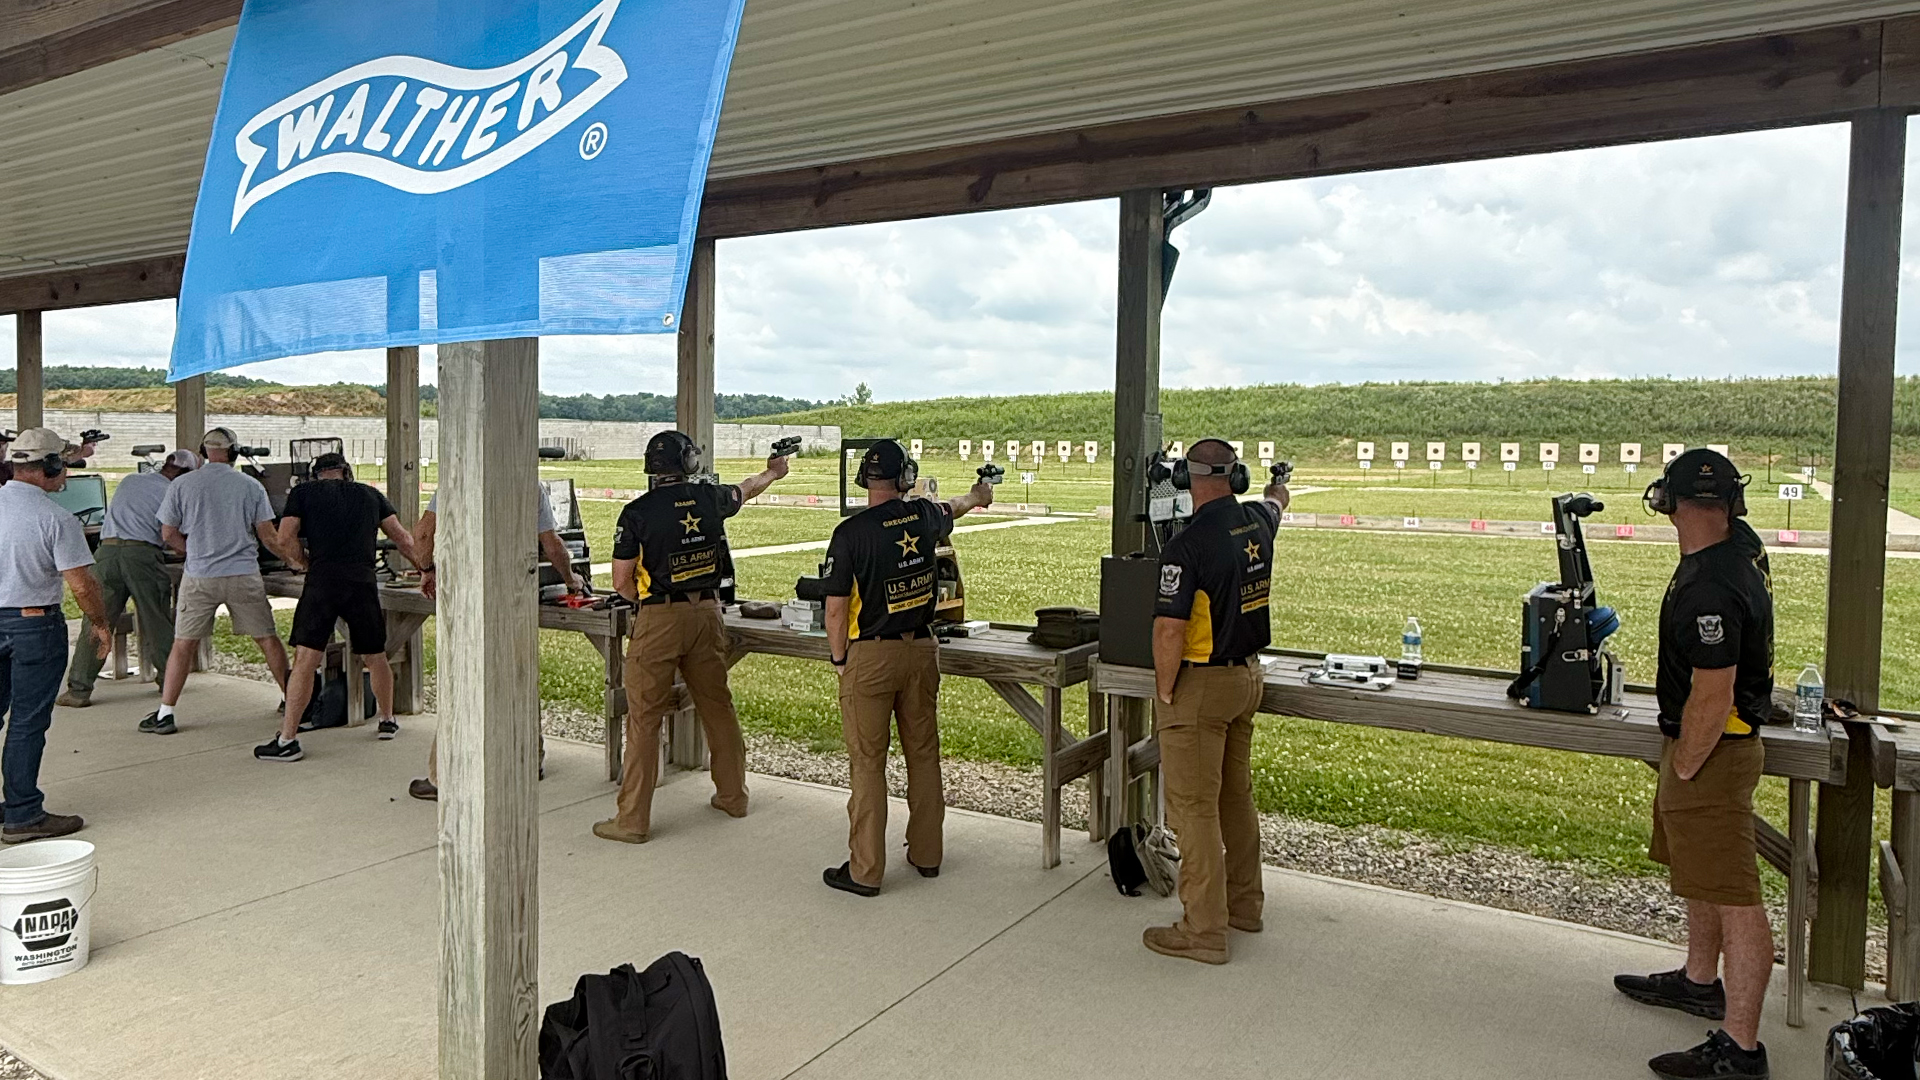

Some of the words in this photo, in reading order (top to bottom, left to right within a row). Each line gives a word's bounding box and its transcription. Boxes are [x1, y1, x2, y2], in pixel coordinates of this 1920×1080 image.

[277, 50, 569, 171] WALTHER
[1782, 486, 1799, 498] 49
[689, 549, 715, 563] ARMY
[887, 581, 909, 594] U.S.
[910, 572, 934, 590] ARMY
[1254, 577, 1270, 592] ARM
[25, 910, 70, 933] NAPA
[14, 943, 77, 962] WASHINGTON
